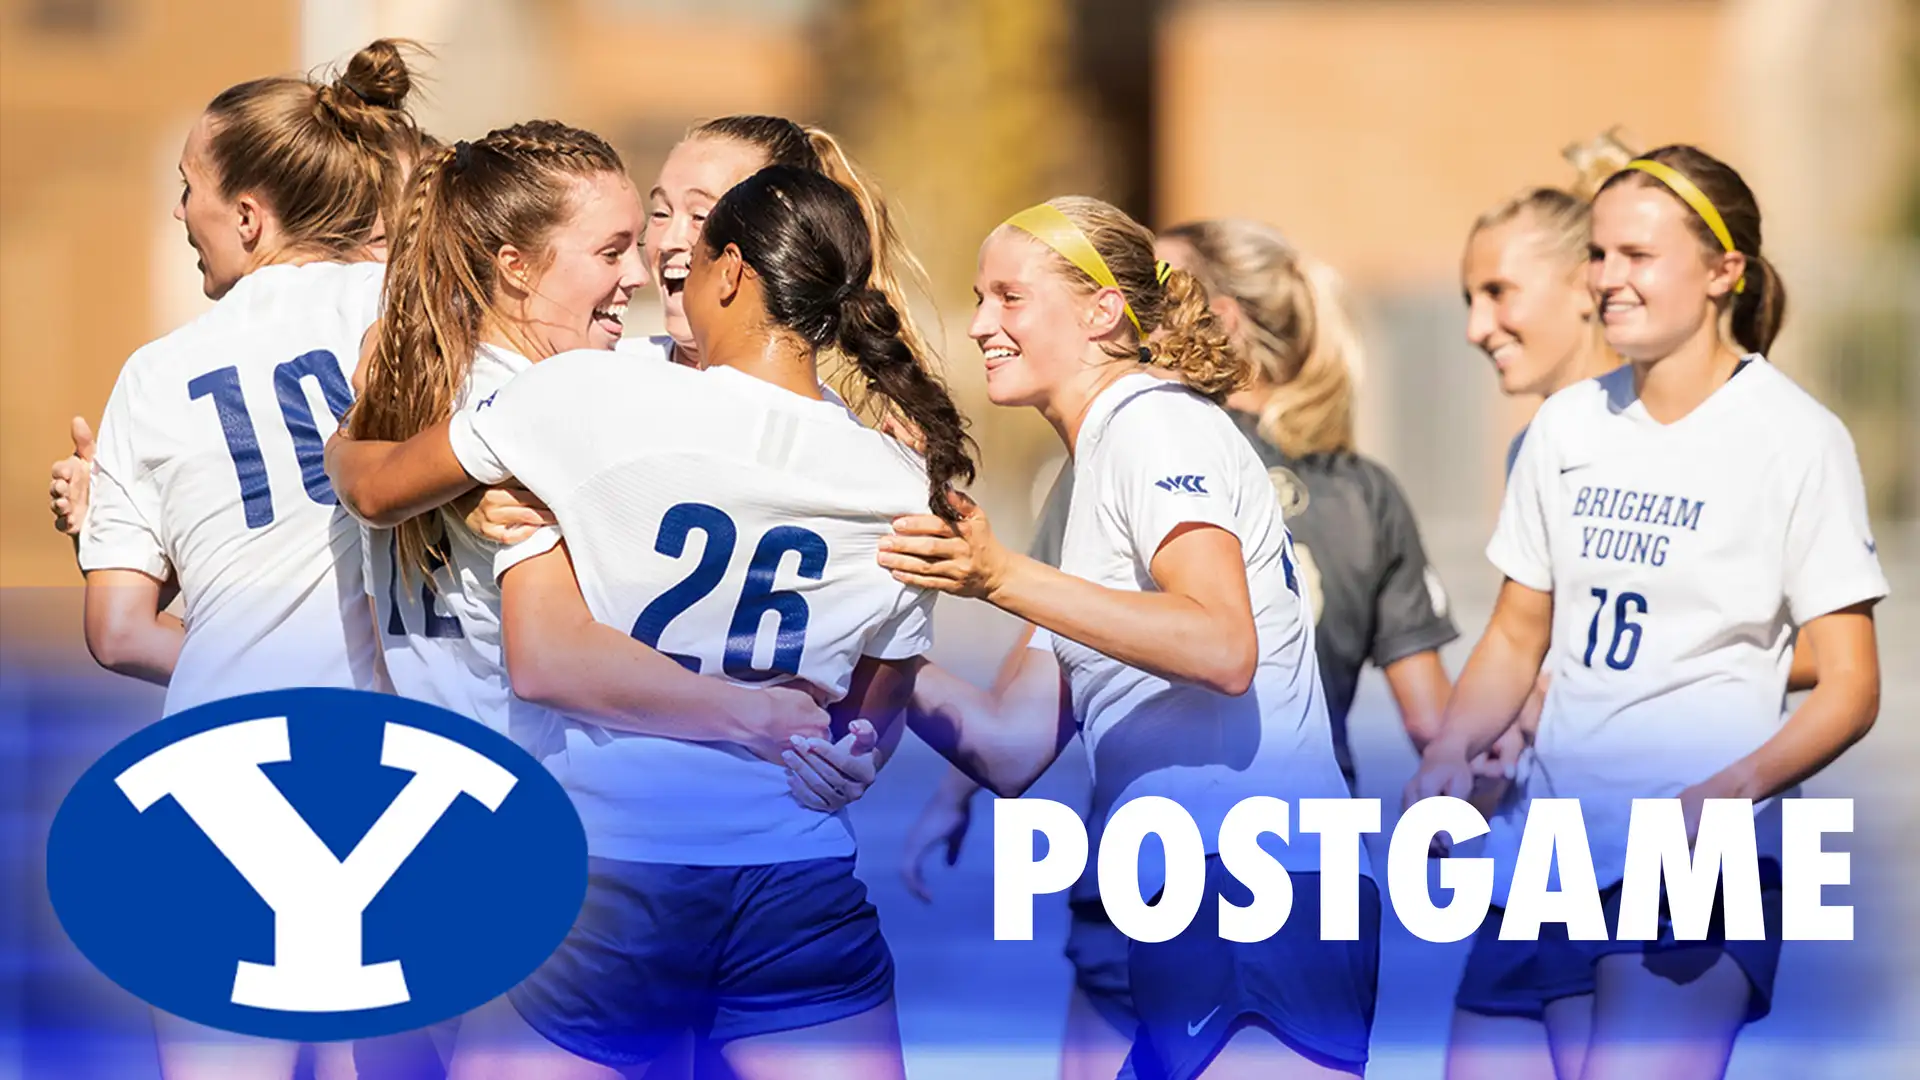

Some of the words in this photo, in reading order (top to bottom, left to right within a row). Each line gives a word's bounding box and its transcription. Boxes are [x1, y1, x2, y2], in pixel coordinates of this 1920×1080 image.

[187, 349, 356, 529] 10
[1154, 474, 1209, 494] WCC
[1572, 486, 1705, 532] BRIGHAM
[1579, 526, 1670, 567] YOUNG
[630, 501, 829, 683] 26
[1583, 586, 1648, 671] 16
